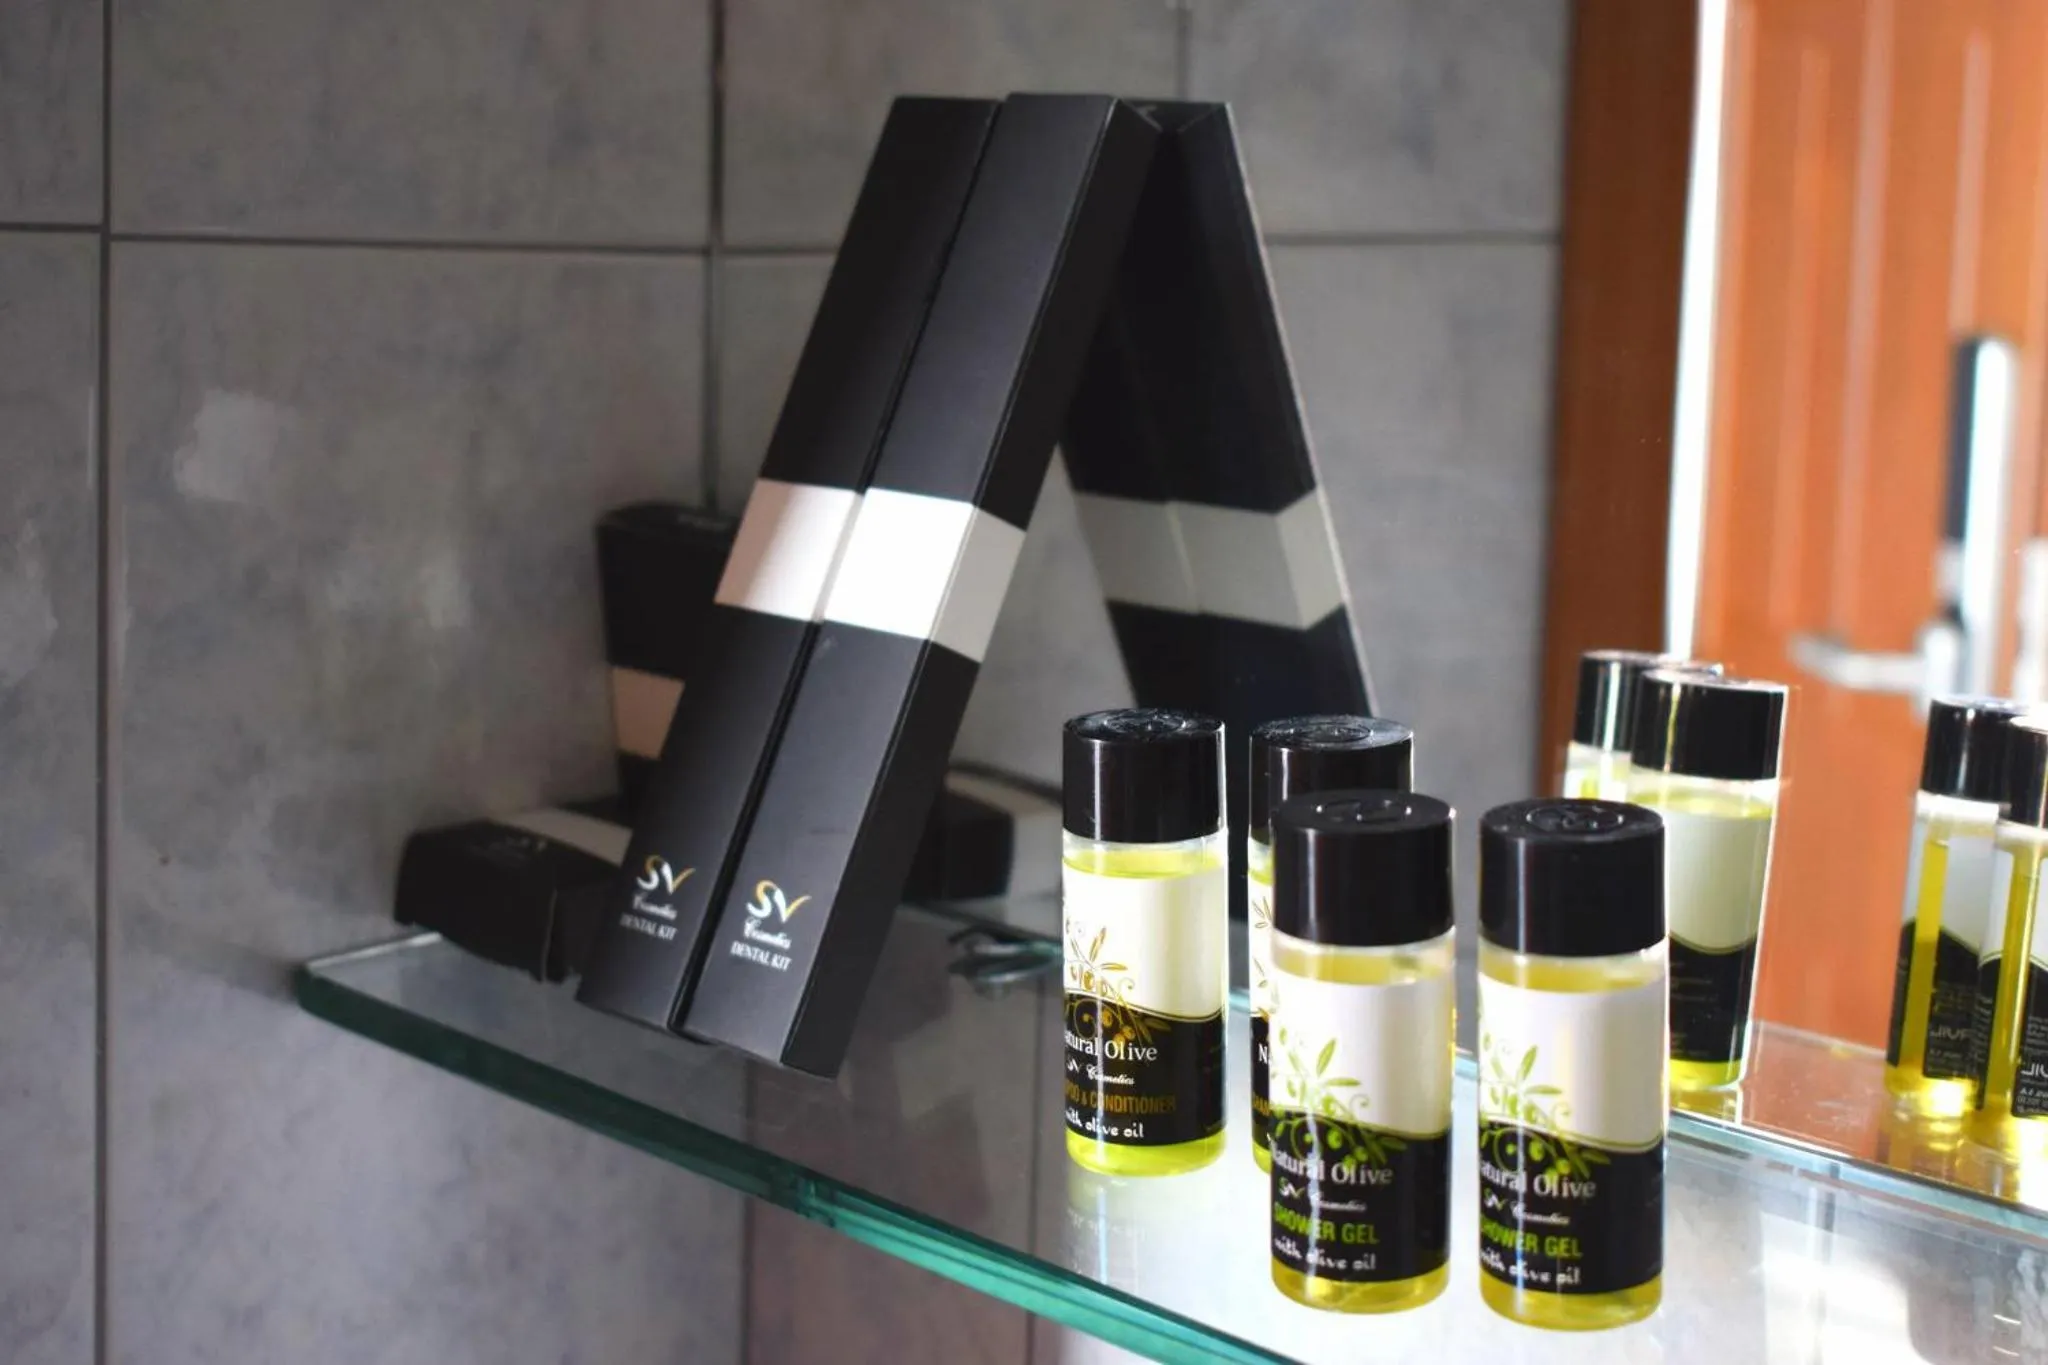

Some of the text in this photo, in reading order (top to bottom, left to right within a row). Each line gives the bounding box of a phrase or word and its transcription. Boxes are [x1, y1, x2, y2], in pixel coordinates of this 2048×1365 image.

[746, 879, 812, 923] SV
[619, 911, 678, 941] DENTAL KIT
[730, 940, 793, 972] DENTAL KIT
[1064, 1029, 1158, 1061] atural Olive
[1085, 1117, 1119, 1137] olive
[1123, 1122, 1145, 1139] oil
[1331, 1162, 1394, 1186] Olive
[1481, 1160, 1597, 1199] atural Olive
[1274, 1202, 1380, 1245] HOWER GEL
[1480, 1213, 1584, 1259] HOWER GEL
[1306, 1248, 1348, 1271] olive
[1353, 1253, 1377, 1271] oil
[1556, 1266, 1581, 1285] oil
